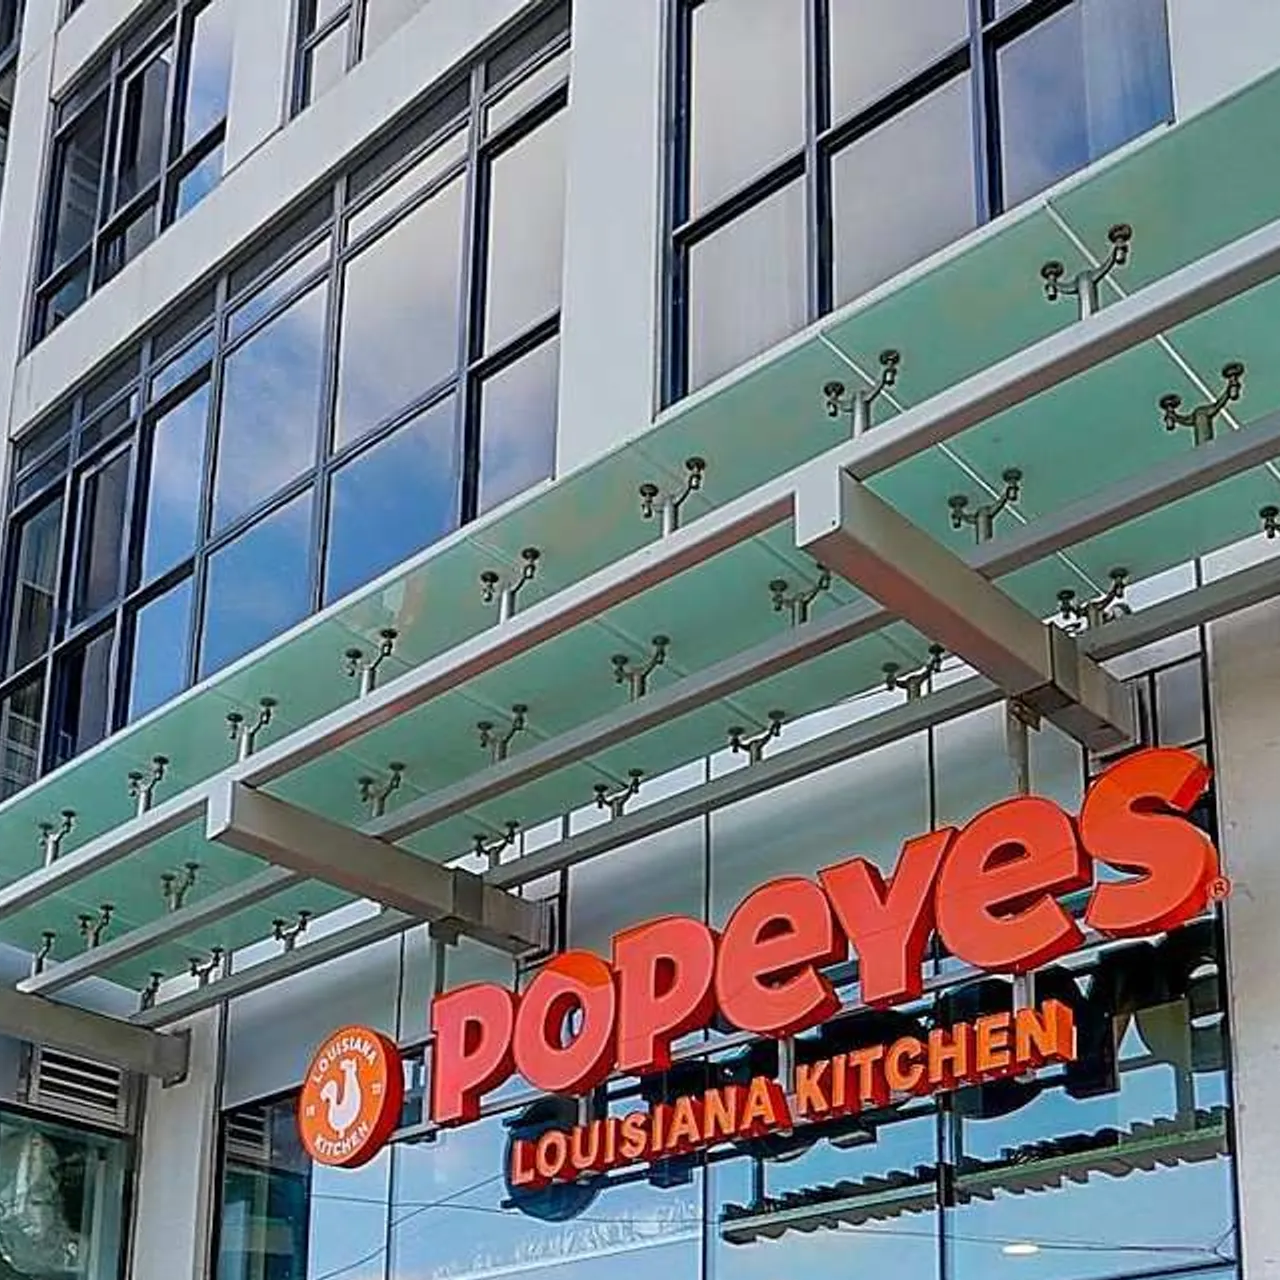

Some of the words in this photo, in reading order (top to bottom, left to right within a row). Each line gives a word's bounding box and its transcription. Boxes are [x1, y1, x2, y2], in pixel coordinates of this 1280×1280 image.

[431, 747, 1220, 1124] POPEYES
[311, 1035, 379, 1083] LOUISIANA
[510, 1076, 794, 1187] LOUISIANA
[796, 1000, 1077, 1117] KITCHEN
[314, 1121, 370, 1157] KITCHEN
